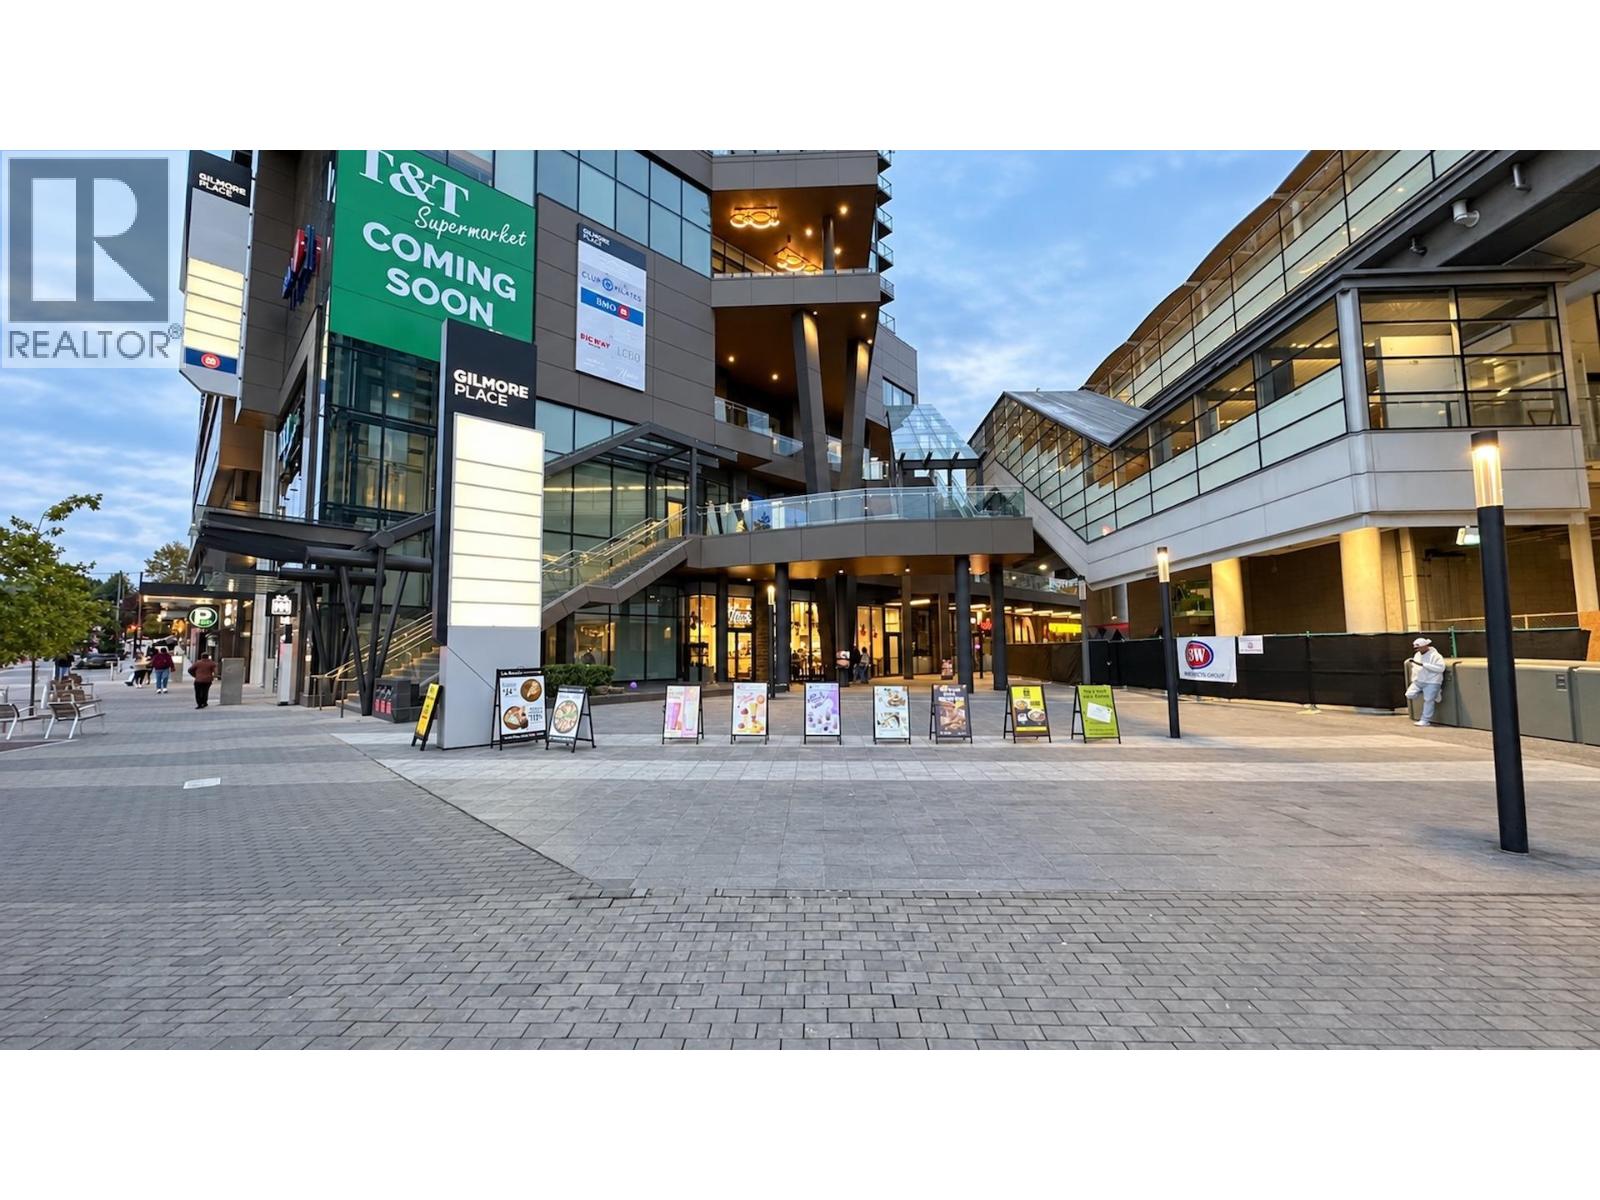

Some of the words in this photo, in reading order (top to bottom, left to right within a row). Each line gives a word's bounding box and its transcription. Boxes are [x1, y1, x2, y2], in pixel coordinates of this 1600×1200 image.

[199, 173, 246, 196] GILMORE
[199, 180, 232, 198] PLACE
[360, 150, 469, 218] T&T
[414, 205, 527, 247] Supermarket
[362, 221, 516, 302] COMING
[385, 267, 493, 327] SOON
[596, 297, 616, 312] BMO
[453, 369, 529, 399] GILMORE
[454, 382, 508, 407] PLACE
